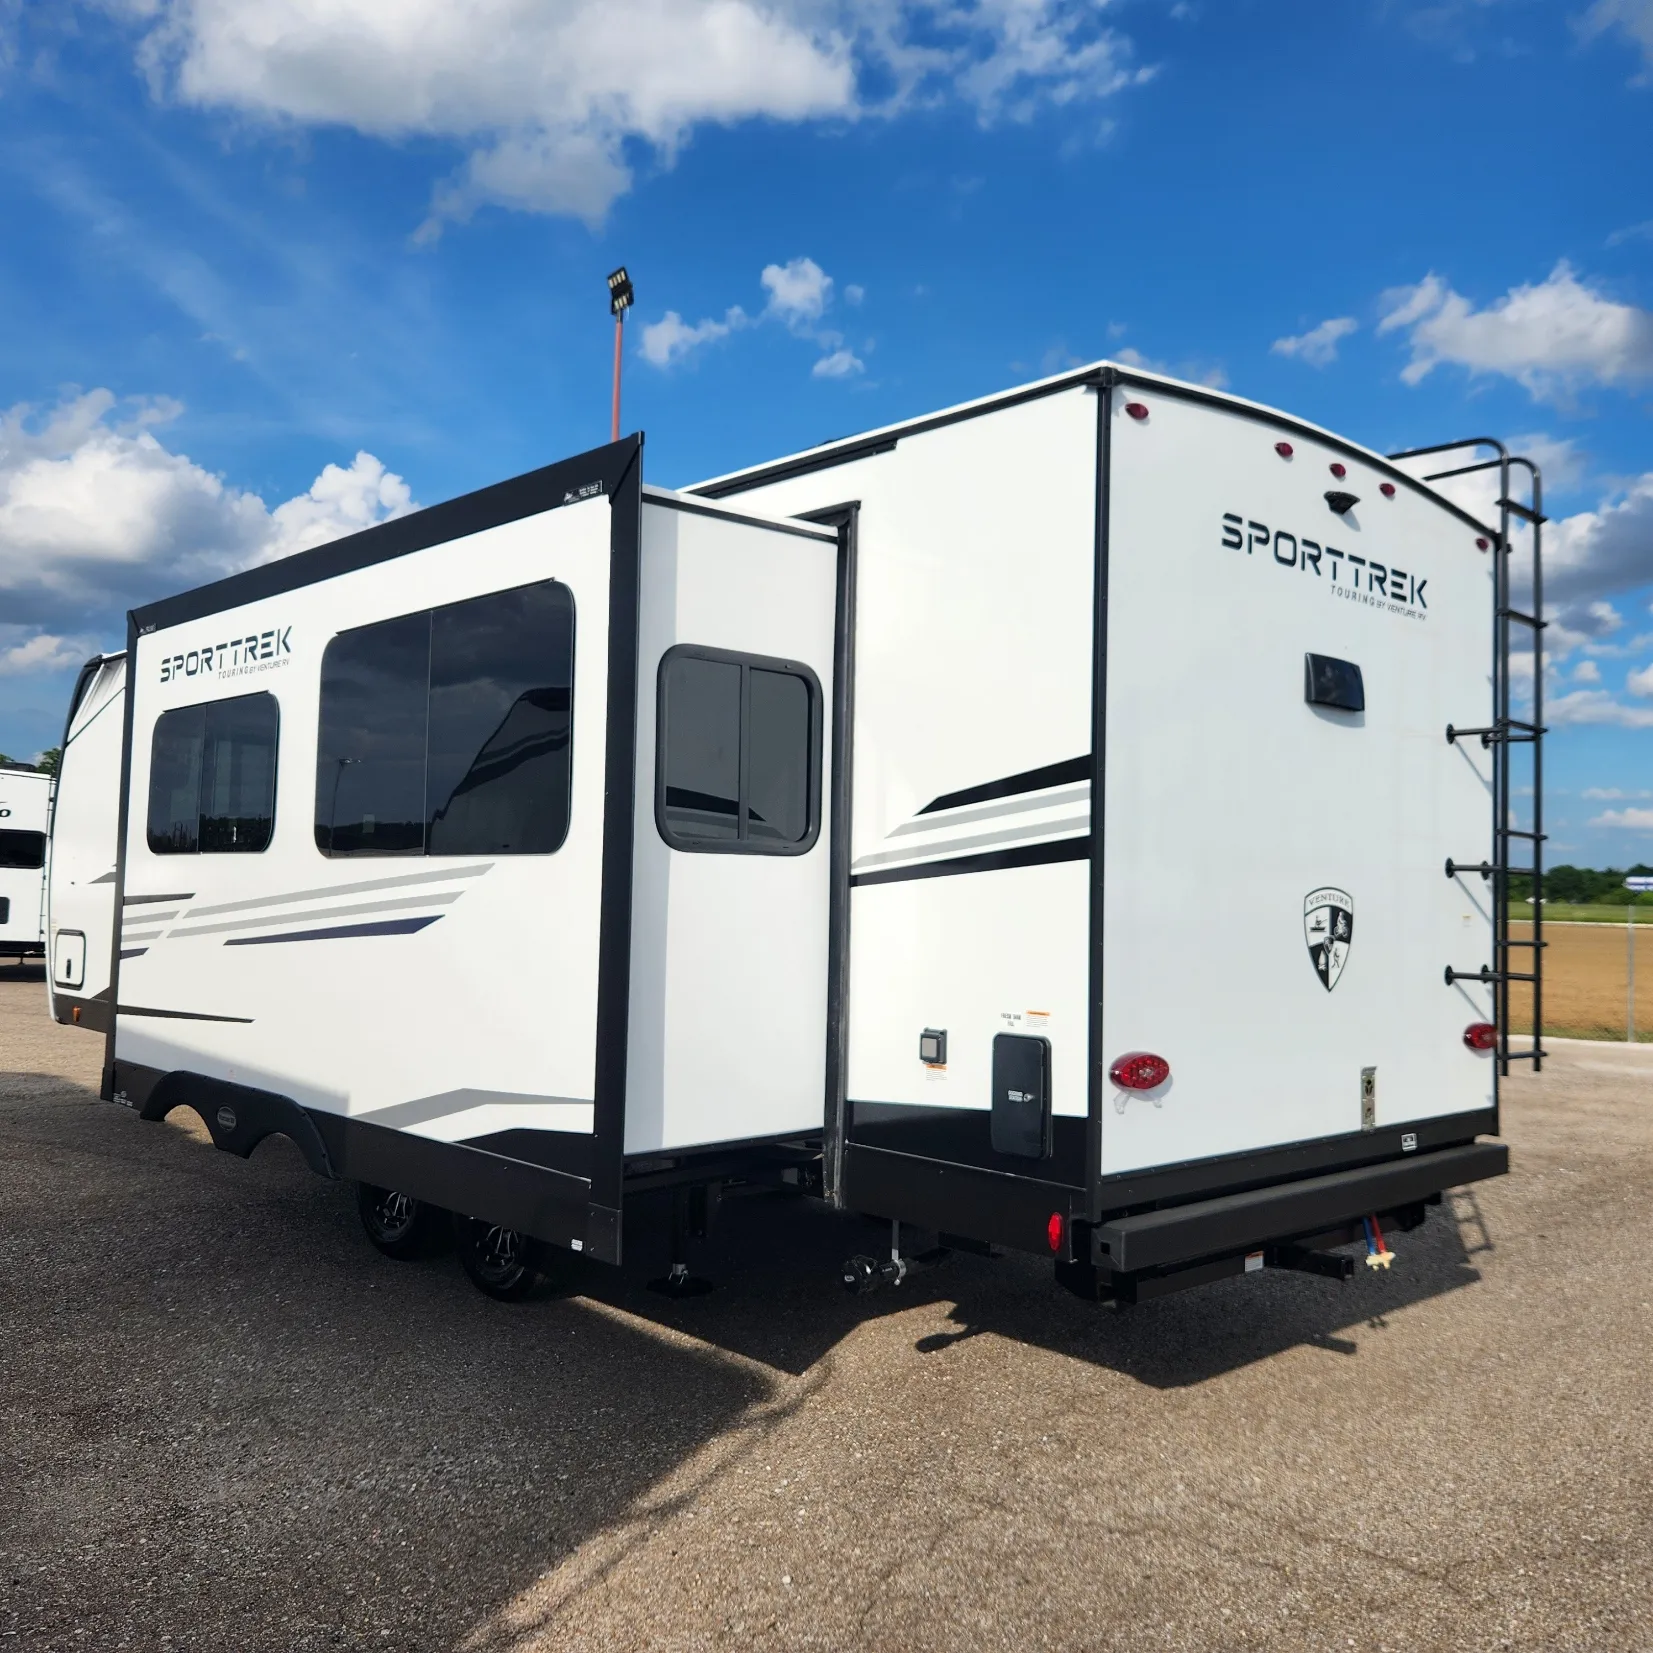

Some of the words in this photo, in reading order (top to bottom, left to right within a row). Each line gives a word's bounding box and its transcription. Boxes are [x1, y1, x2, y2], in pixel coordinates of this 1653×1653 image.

[1221, 512, 1428, 609] SPORTTREK
[1330, 585, 1375, 607] TOURING
[1376, 601, 1386, 609] BY
[1387, 604, 1416, 618] VENTURE
[160, 625, 292, 683] SPORTTREK
[218, 666, 251, 680] TOURING
[257, 660, 282, 672] VENTURE
[282, 659, 290, 667] RV
[1308, 893, 1350, 908] VENTURE
